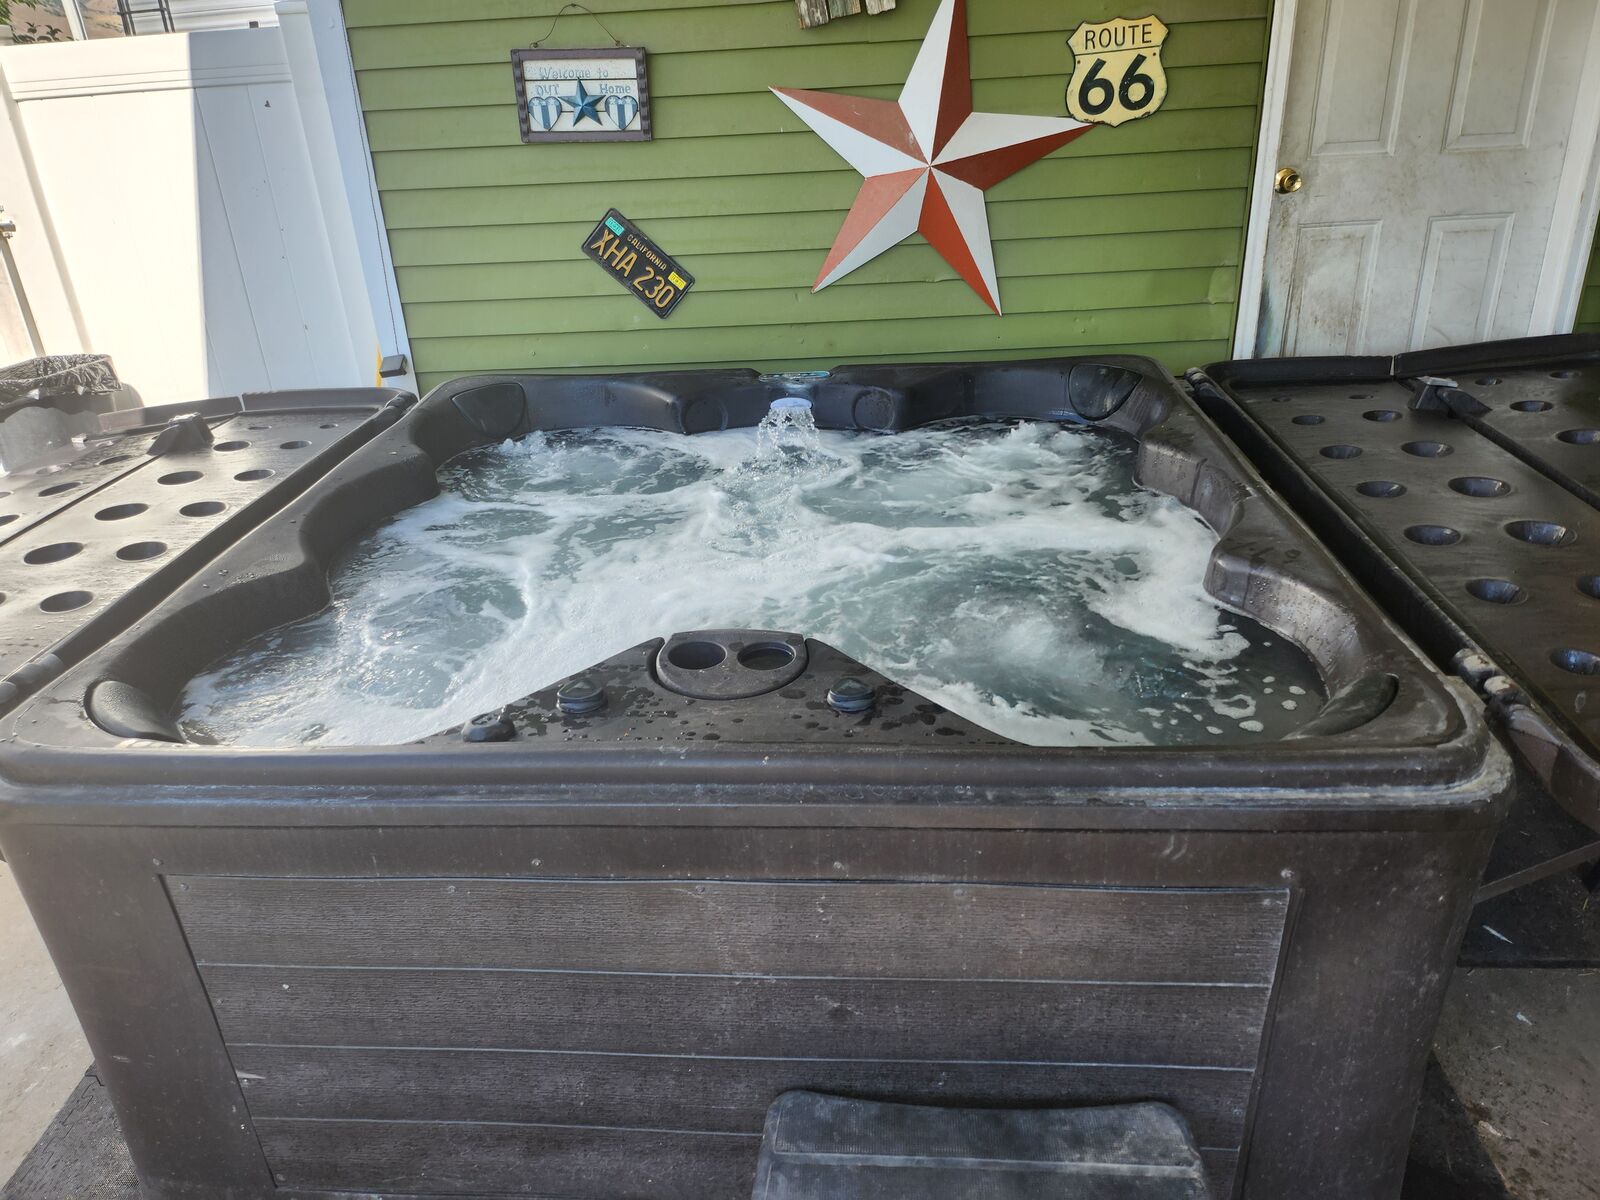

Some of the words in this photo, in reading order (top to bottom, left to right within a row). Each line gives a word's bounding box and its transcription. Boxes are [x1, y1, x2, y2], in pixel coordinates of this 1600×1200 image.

[1085, 23, 1152, 50] ROUTE
[541, 67, 591, 79] Welcome
[597, 68, 609, 78] to
[600, 83, 632, 94] Home
[1078, 53, 1155, 116] 66
[590, 229, 638, 278] XHA
[633, 266, 675, 308] 230
[626, 233, 667, 272] CALIFORNIA
